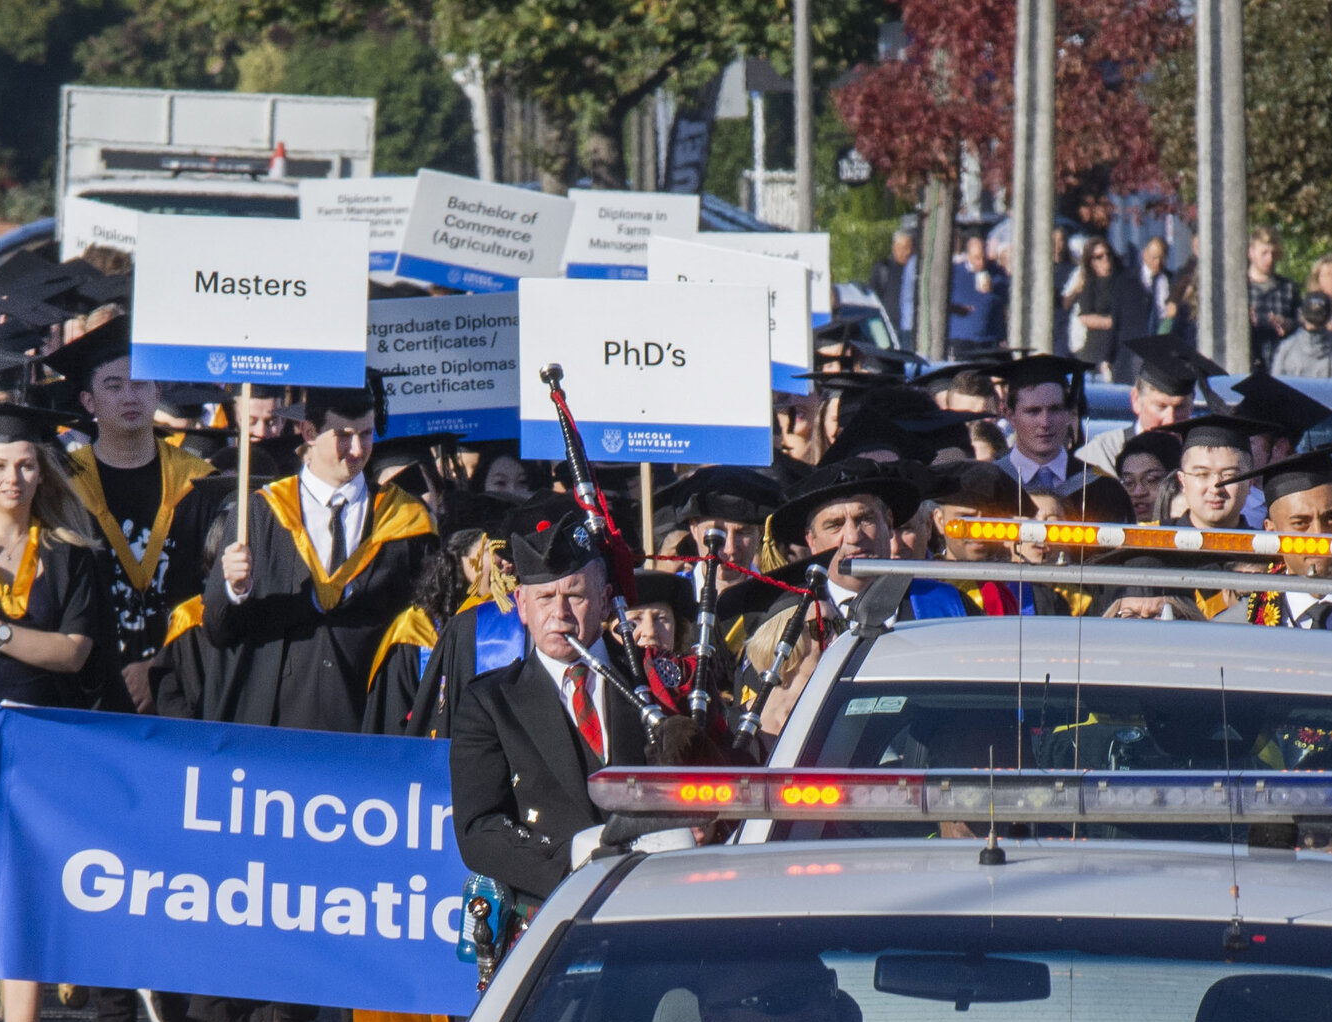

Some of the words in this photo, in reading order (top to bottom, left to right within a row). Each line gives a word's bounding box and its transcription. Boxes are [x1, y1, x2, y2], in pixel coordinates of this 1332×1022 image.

[447, 196, 516, 221] Bachelor
[521, 211, 539, 225] of
[598, 206, 653, 222] Diploma
[655, 211, 667, 221] in
[444, 214, 532, 243] Commerce
[617, 224, 651, 235] Farm
[432, 229, 535, 263] (Agriculture)
[195, 270, 307, 297] Masters
[377, 339, 389, 353] &
[393, 334, 487, 352] Certificates
[232, 355, 272, 363] LINCOLN
[604, 340, 686, 367] PhD's
[232, 362, 289, 371] UNIVERSITY
[441, 358, 516, 376] Diplomas
[386, 383, 396, 396] &
[401, 378, 495, 395] Certificates
[628, 431, 671, 440] LINCOLN
[628, 439, 690, 448] UNIVERSITY
